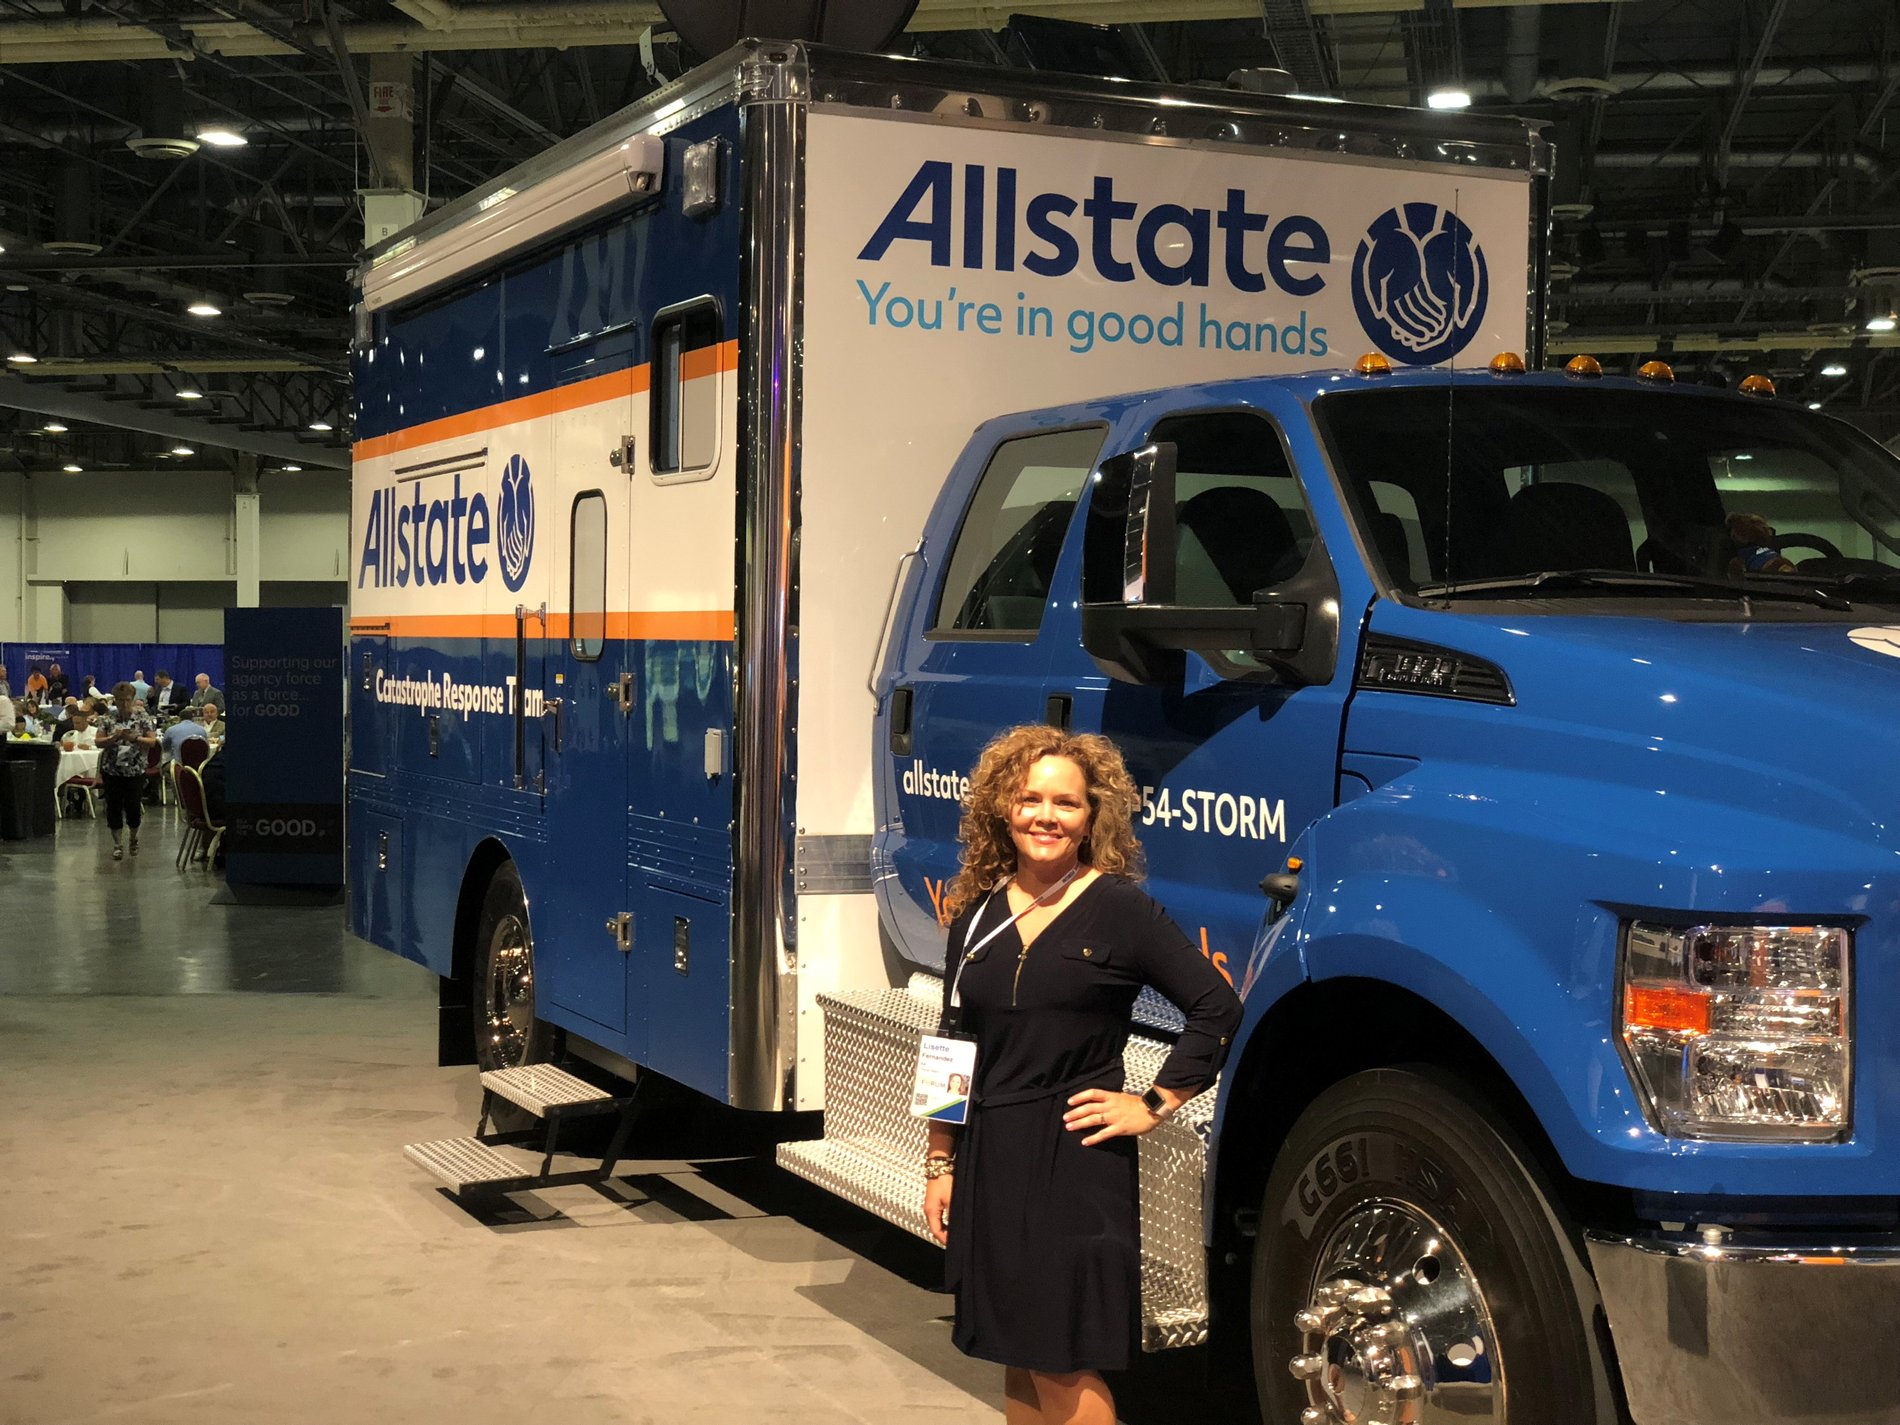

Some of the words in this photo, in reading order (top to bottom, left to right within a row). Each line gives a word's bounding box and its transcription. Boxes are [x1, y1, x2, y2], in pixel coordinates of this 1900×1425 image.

[374, 86, 394, 98] FIRE
[856, 160, 1331, 297] Allstate
[856, 279, 1002, 335] You're
[1017, 292, 1053, 338] in
[1067, 301, 1184, 354] good
[1200, 303, 1329, 357] hands
[358, 473, 490, 589] Allstate
[231, 655, 309, 672] Supporting
[313, 658, 337, 669] our
[231, 674, 282, 688] agency
[286, 672, 321, 685] force
[232, 690, 248, 701] as
[252, 690, 260, 701] a
[264, 688, 310, 702] force...
[375, 669, 441, 717] Catastrophe
[443, 672, 504, 722] Response
[506, 675, 545, 718] Tam
[232, 704, 251, 717] for
[255, 704, 300, 717] GOOD
[923, 1042, 950, 1053] Lisette
[922, 1052, 954, 1063] Fernandez
[1298, 1137, 1370, 1217] G661
